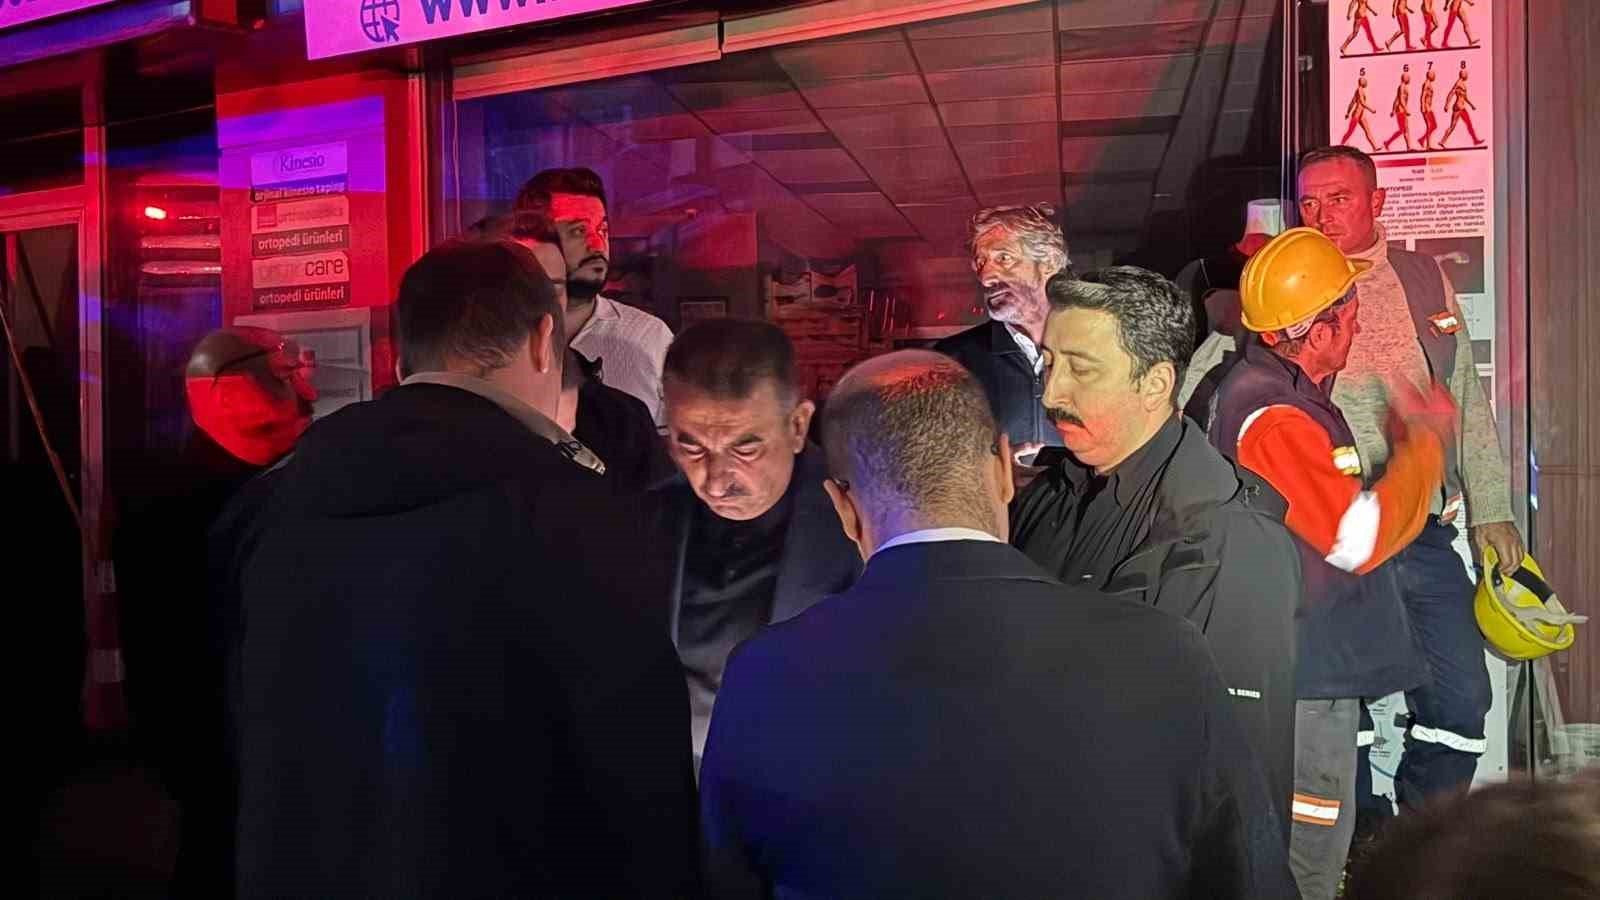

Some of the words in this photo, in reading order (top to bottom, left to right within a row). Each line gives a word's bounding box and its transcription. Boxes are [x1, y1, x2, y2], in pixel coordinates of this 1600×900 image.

[1359, 67, 1366, 77] 5
[1402, 64, 1410, 73] 6
[1427, 61, 1434, 70] 7
[1460, 60, 1467, 70] 8
[258, 232, 301, 250] ortopedi
[302, 229, 343, 246] ürünleri
[259, 290, 302, 306] ortopedi
[303, 286, 345, 302] ürünleri
